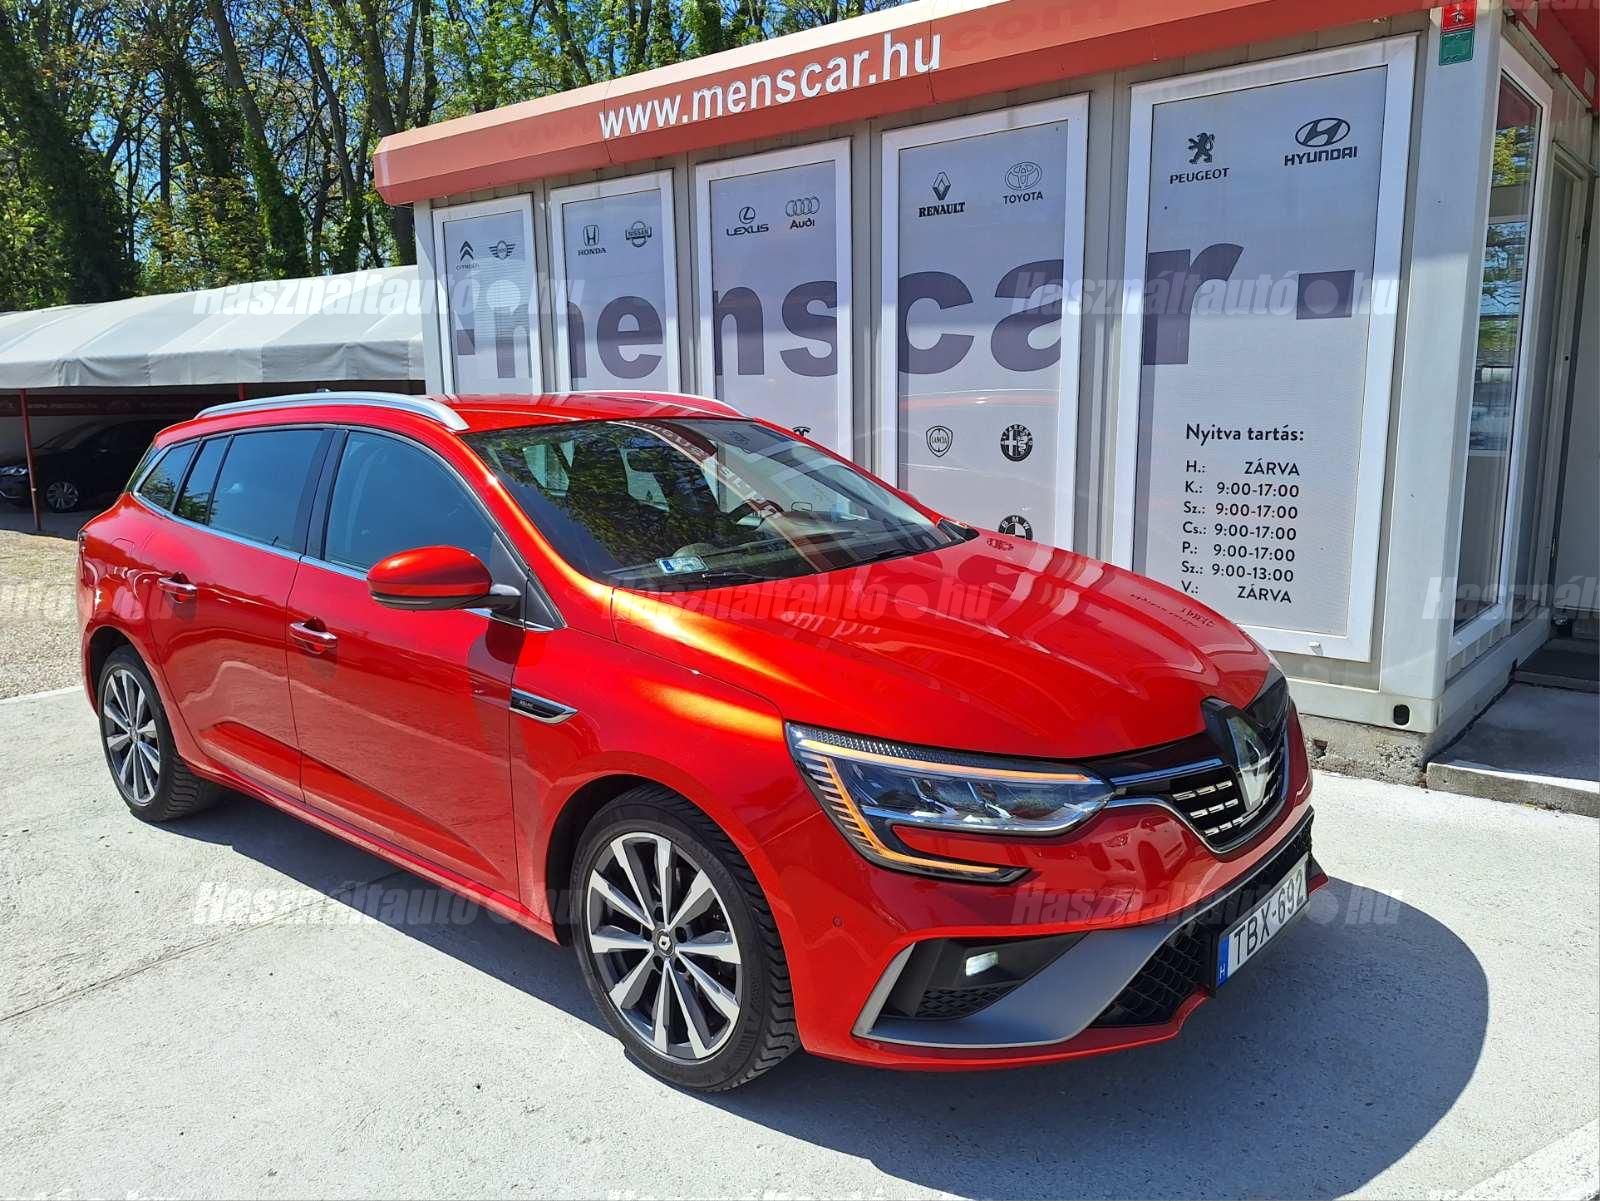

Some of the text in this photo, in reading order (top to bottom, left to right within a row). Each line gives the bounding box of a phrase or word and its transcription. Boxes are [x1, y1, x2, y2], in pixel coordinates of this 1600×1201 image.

[599, 32, 942, 139] www.menscar.hu
[1284, 146, 1358, 166] HYUNDAI
[1170, 168, 1230, 184] PEUGEOT
[1003, 191, 1044, 204] TOYOTA
[919, 202, 966, 217] RENAULT
[726, 223, 769, 236] LEXUS
[790, 218, 815, 229] Audi
[578, 247, 607, 256] HONDA
[1186, 423, 1304, 446] Nyitva tartás:
[1186, 458, 1300, 476] H.: ZÁRVA
[1185, 480, 1299, 498] K.: 9:00-17:00
[1183, 501, 1298, 519] Sz.: 9:00-17:00
[1182, 521, 1297, 541] Cs.: 9:00-17:00
[1182, 541, 1295, 561] P.: 9:00-17:00
[1181, 561, 1294, 582] Sz.: 9:00-13:00
[1181, 580, 1292, 603] V.: ZÁRVA
[1233, 868, 1304, 966] TBX-692
